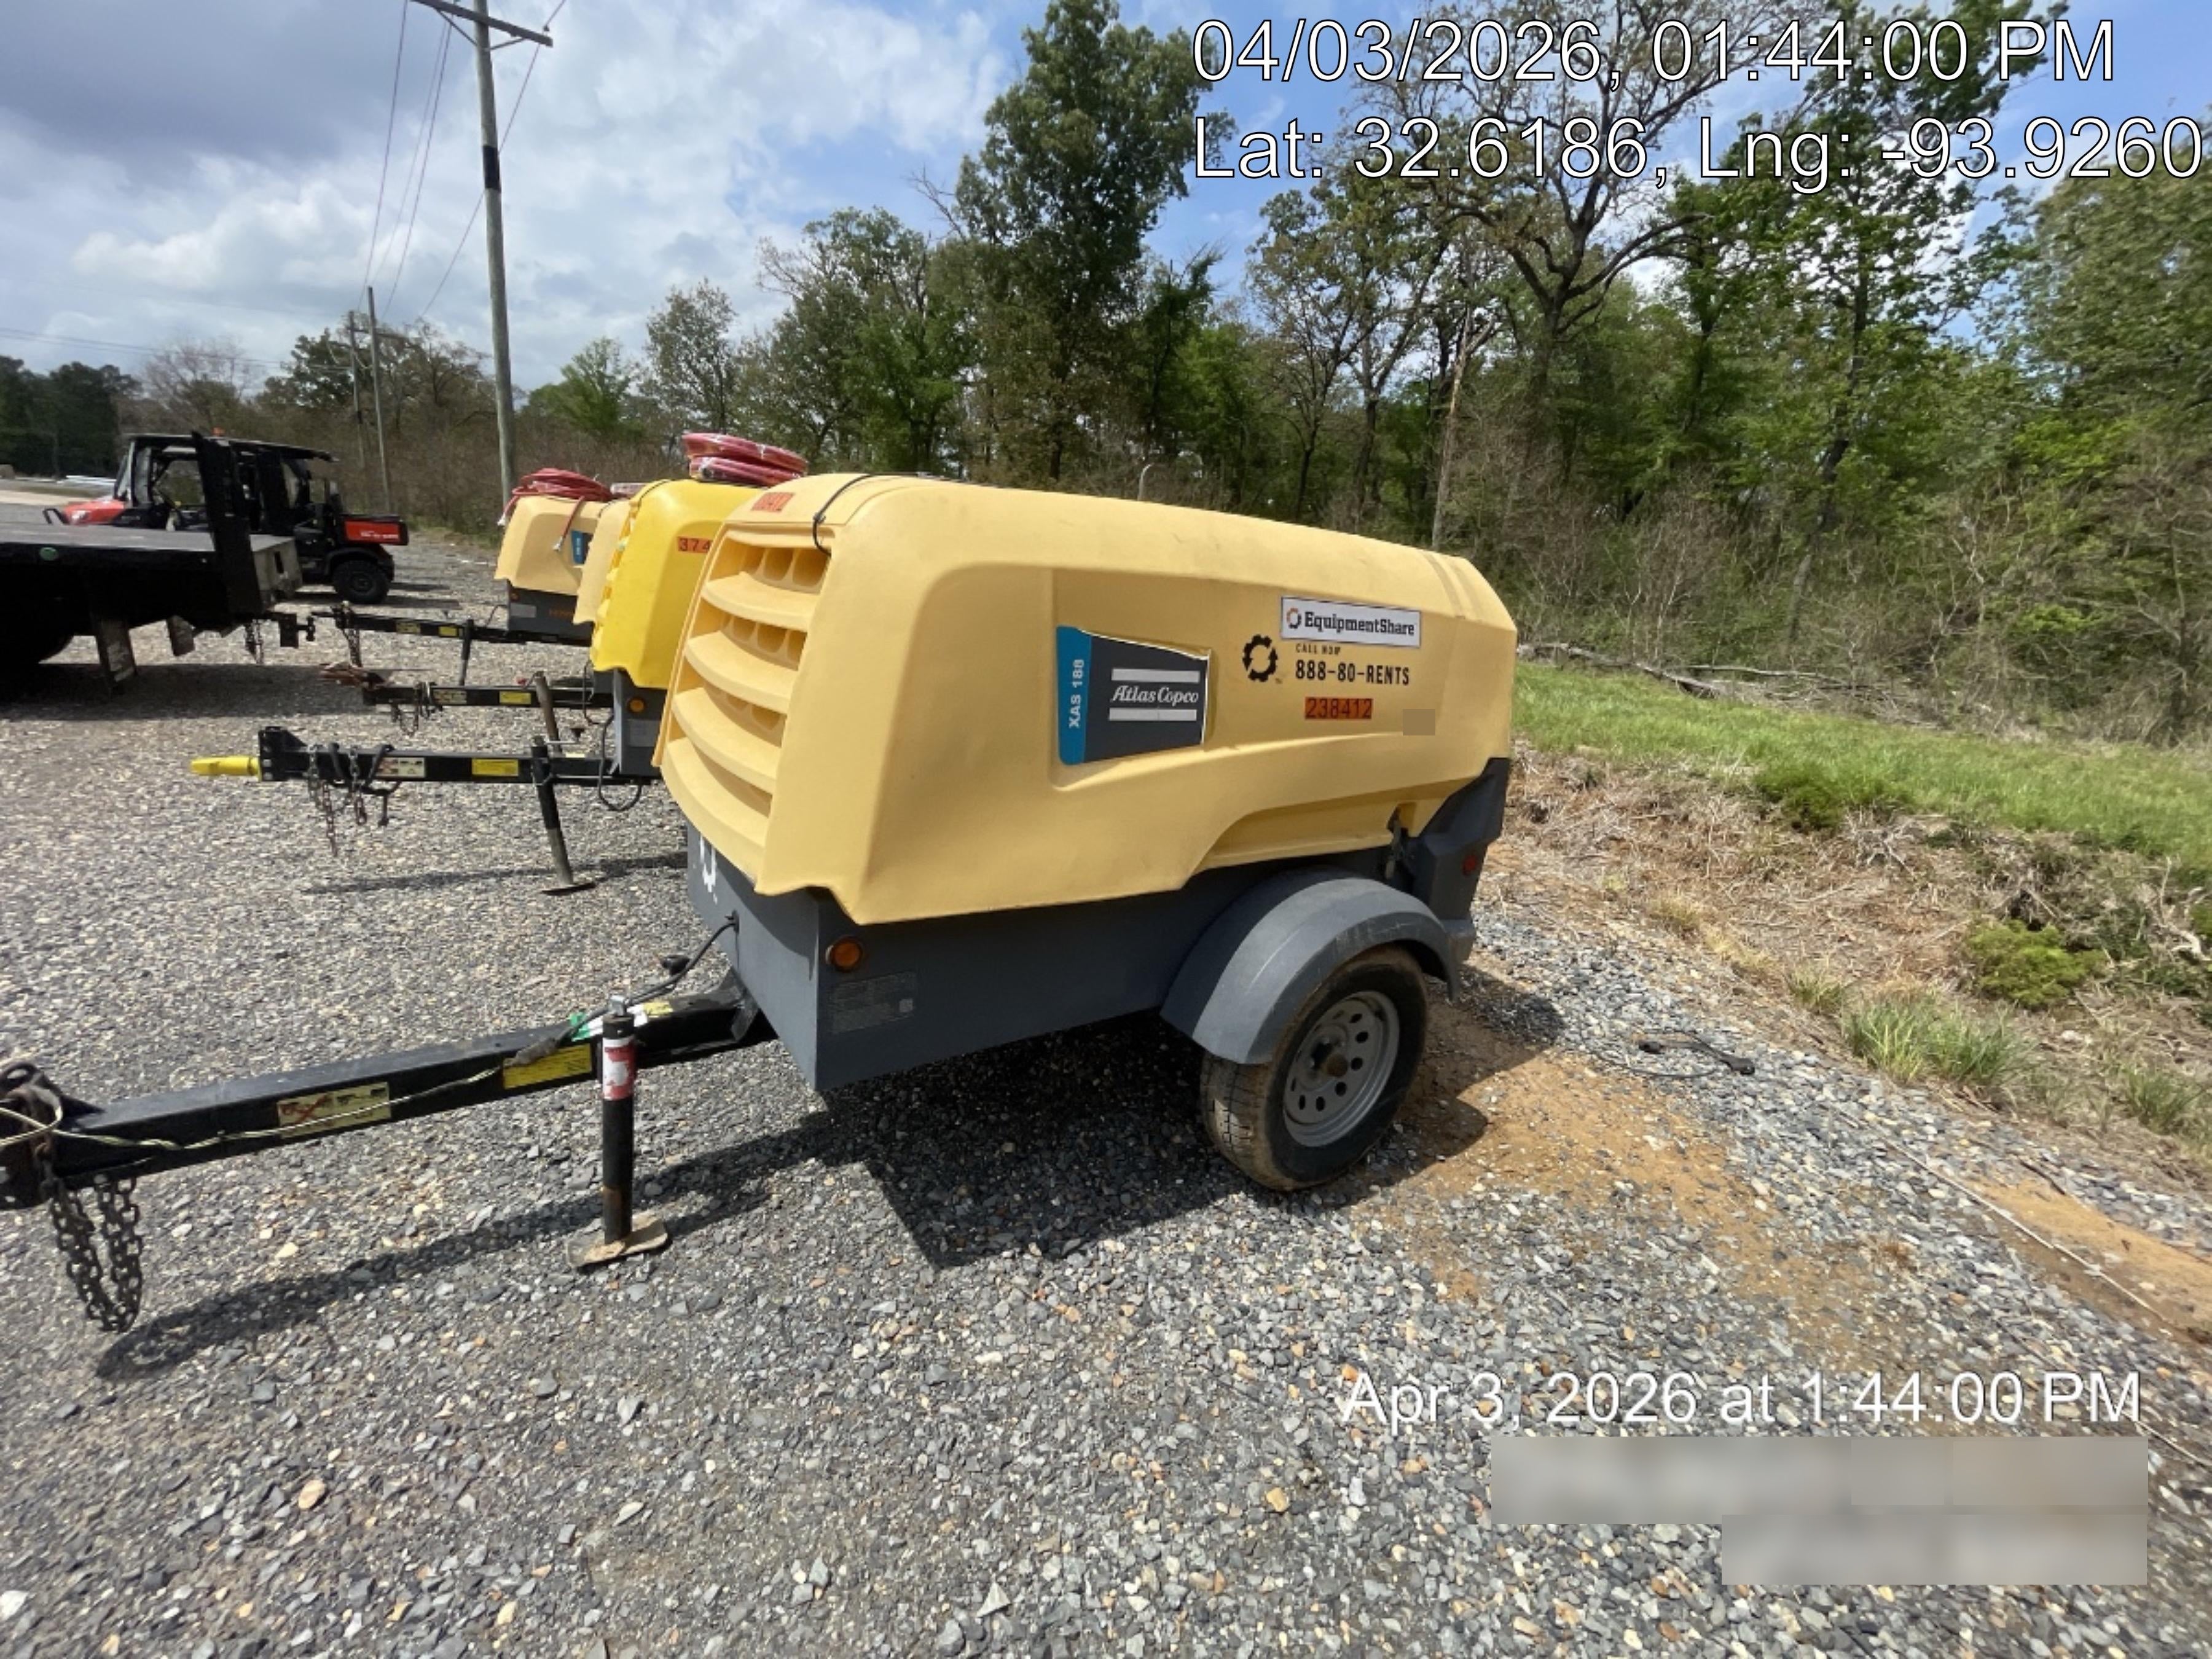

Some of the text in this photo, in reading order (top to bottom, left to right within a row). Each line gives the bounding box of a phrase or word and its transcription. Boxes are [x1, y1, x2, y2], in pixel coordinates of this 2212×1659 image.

[1304, 611, 1414, 635] EquipmentShare
[1295, 643, 1318, 654] CALL
[1295, 659, 1410, 686] 888-80-RENTS
[1111, 685, 1199, 707] Atlas Copco
[1069, 695, 1081, 728] XAS
[1306, 698, 1371, 718] 238412
